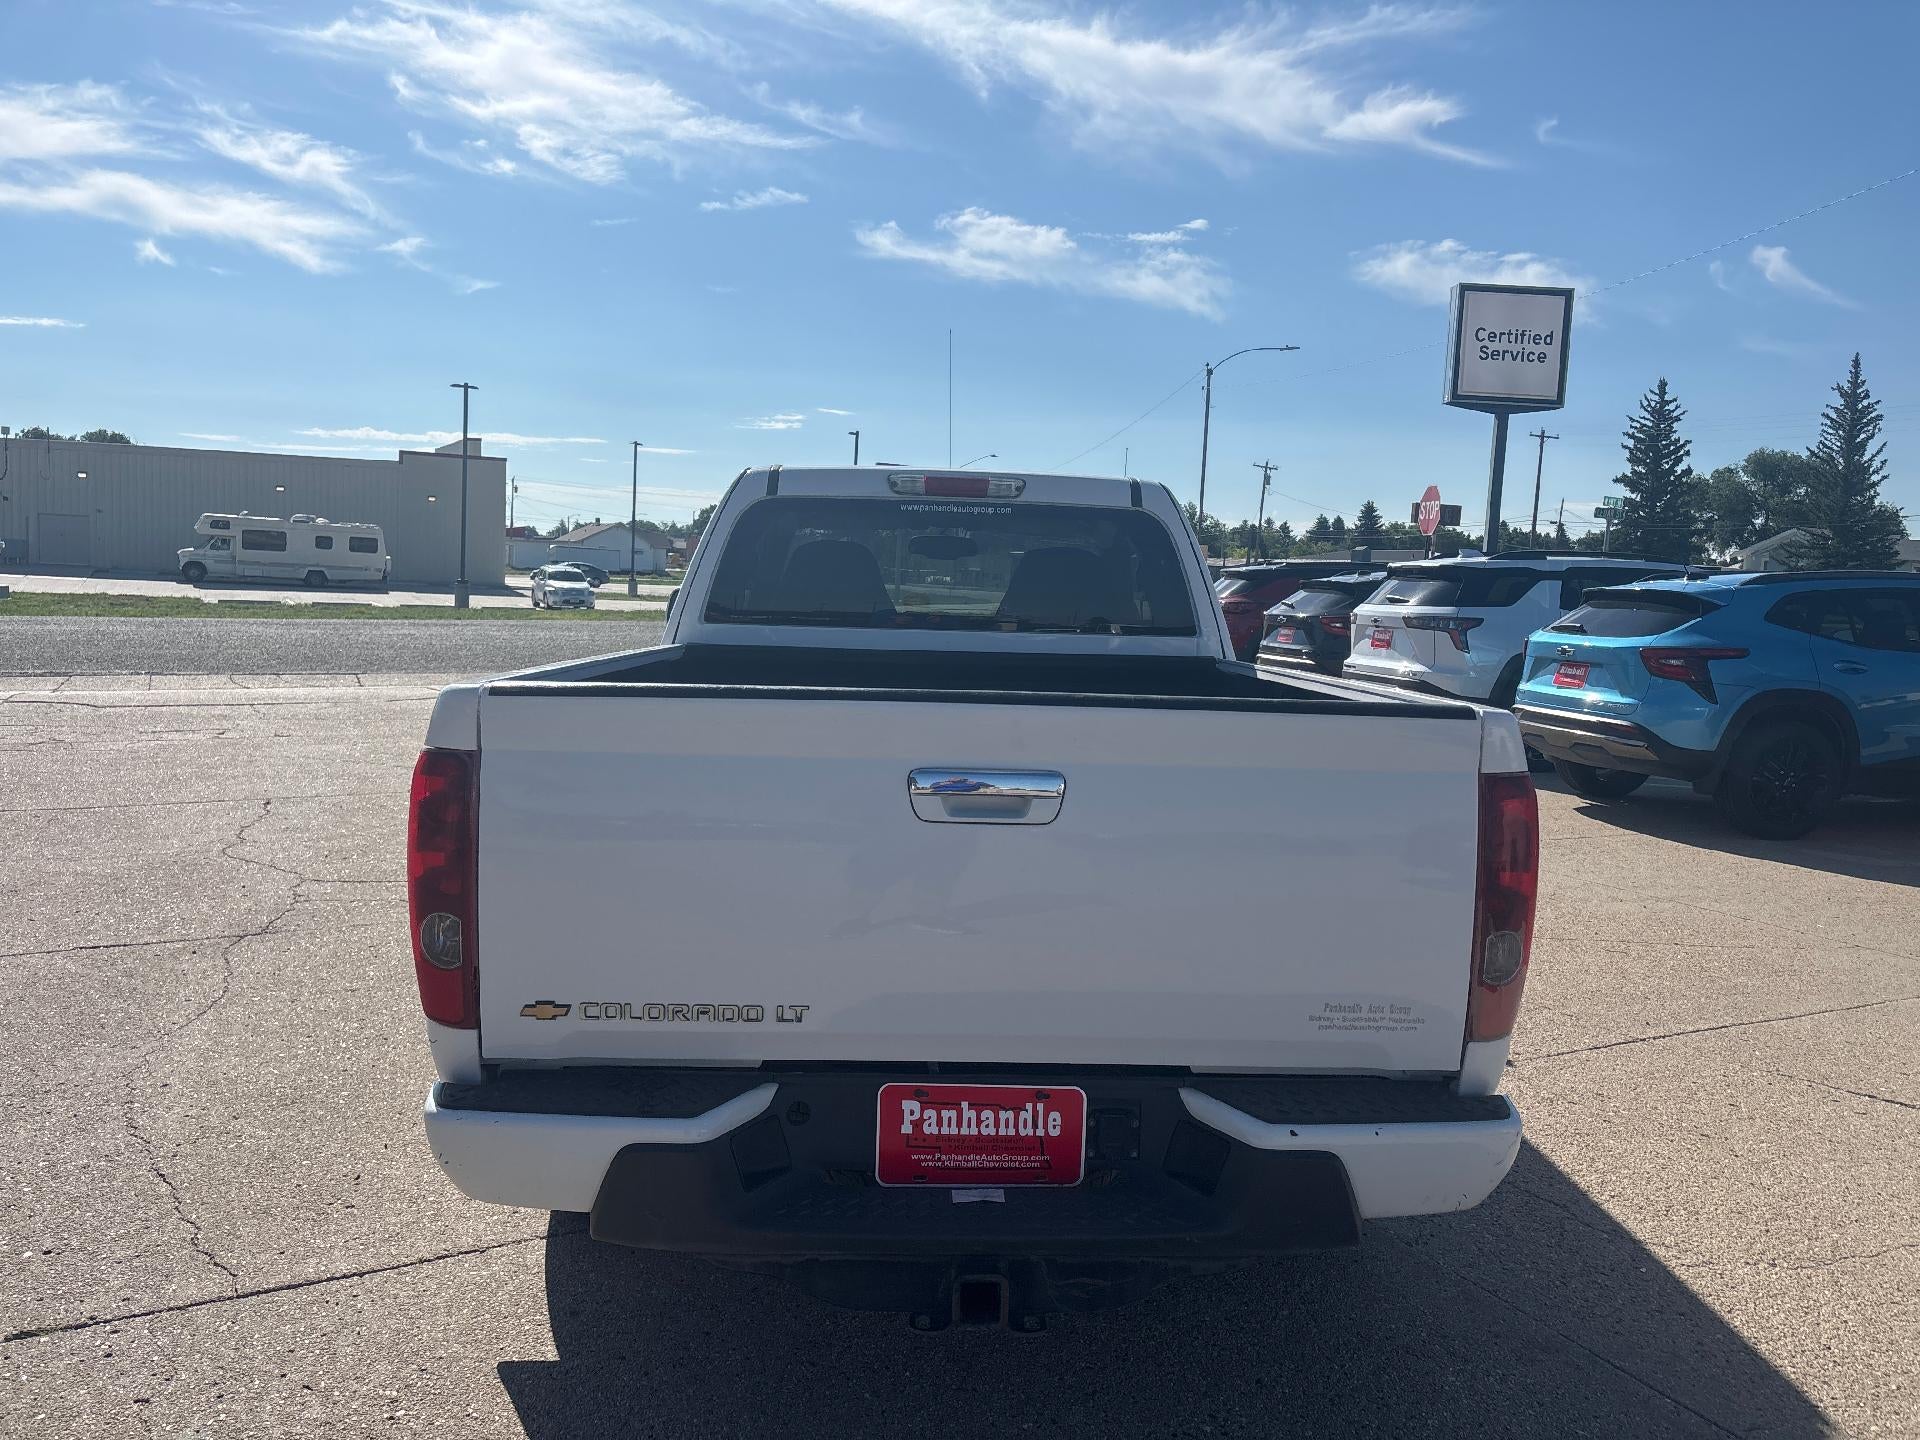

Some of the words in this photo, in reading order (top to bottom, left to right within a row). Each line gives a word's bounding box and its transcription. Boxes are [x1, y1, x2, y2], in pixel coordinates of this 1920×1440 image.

[1474, 327, 1554, 346] Certified
[1478, 345, 1547, 363] Service
[900, 503, 1012, 515] www.panhandleautogroup.com
[1420, 500, 1440, 520] STOP
[1560, 665, 1586, 676] Kimball
[578, 1002, 764, 1023] COLORADO
[775, 1004, 810, 1023] LT
[901, 1099, 1062, 1137] Panhandle
[911, 1153, 1050, 1162] www.PanhandleAutoGroup.com
[920, 1160, 1040, 1168] www.KimballChevrolet.com
